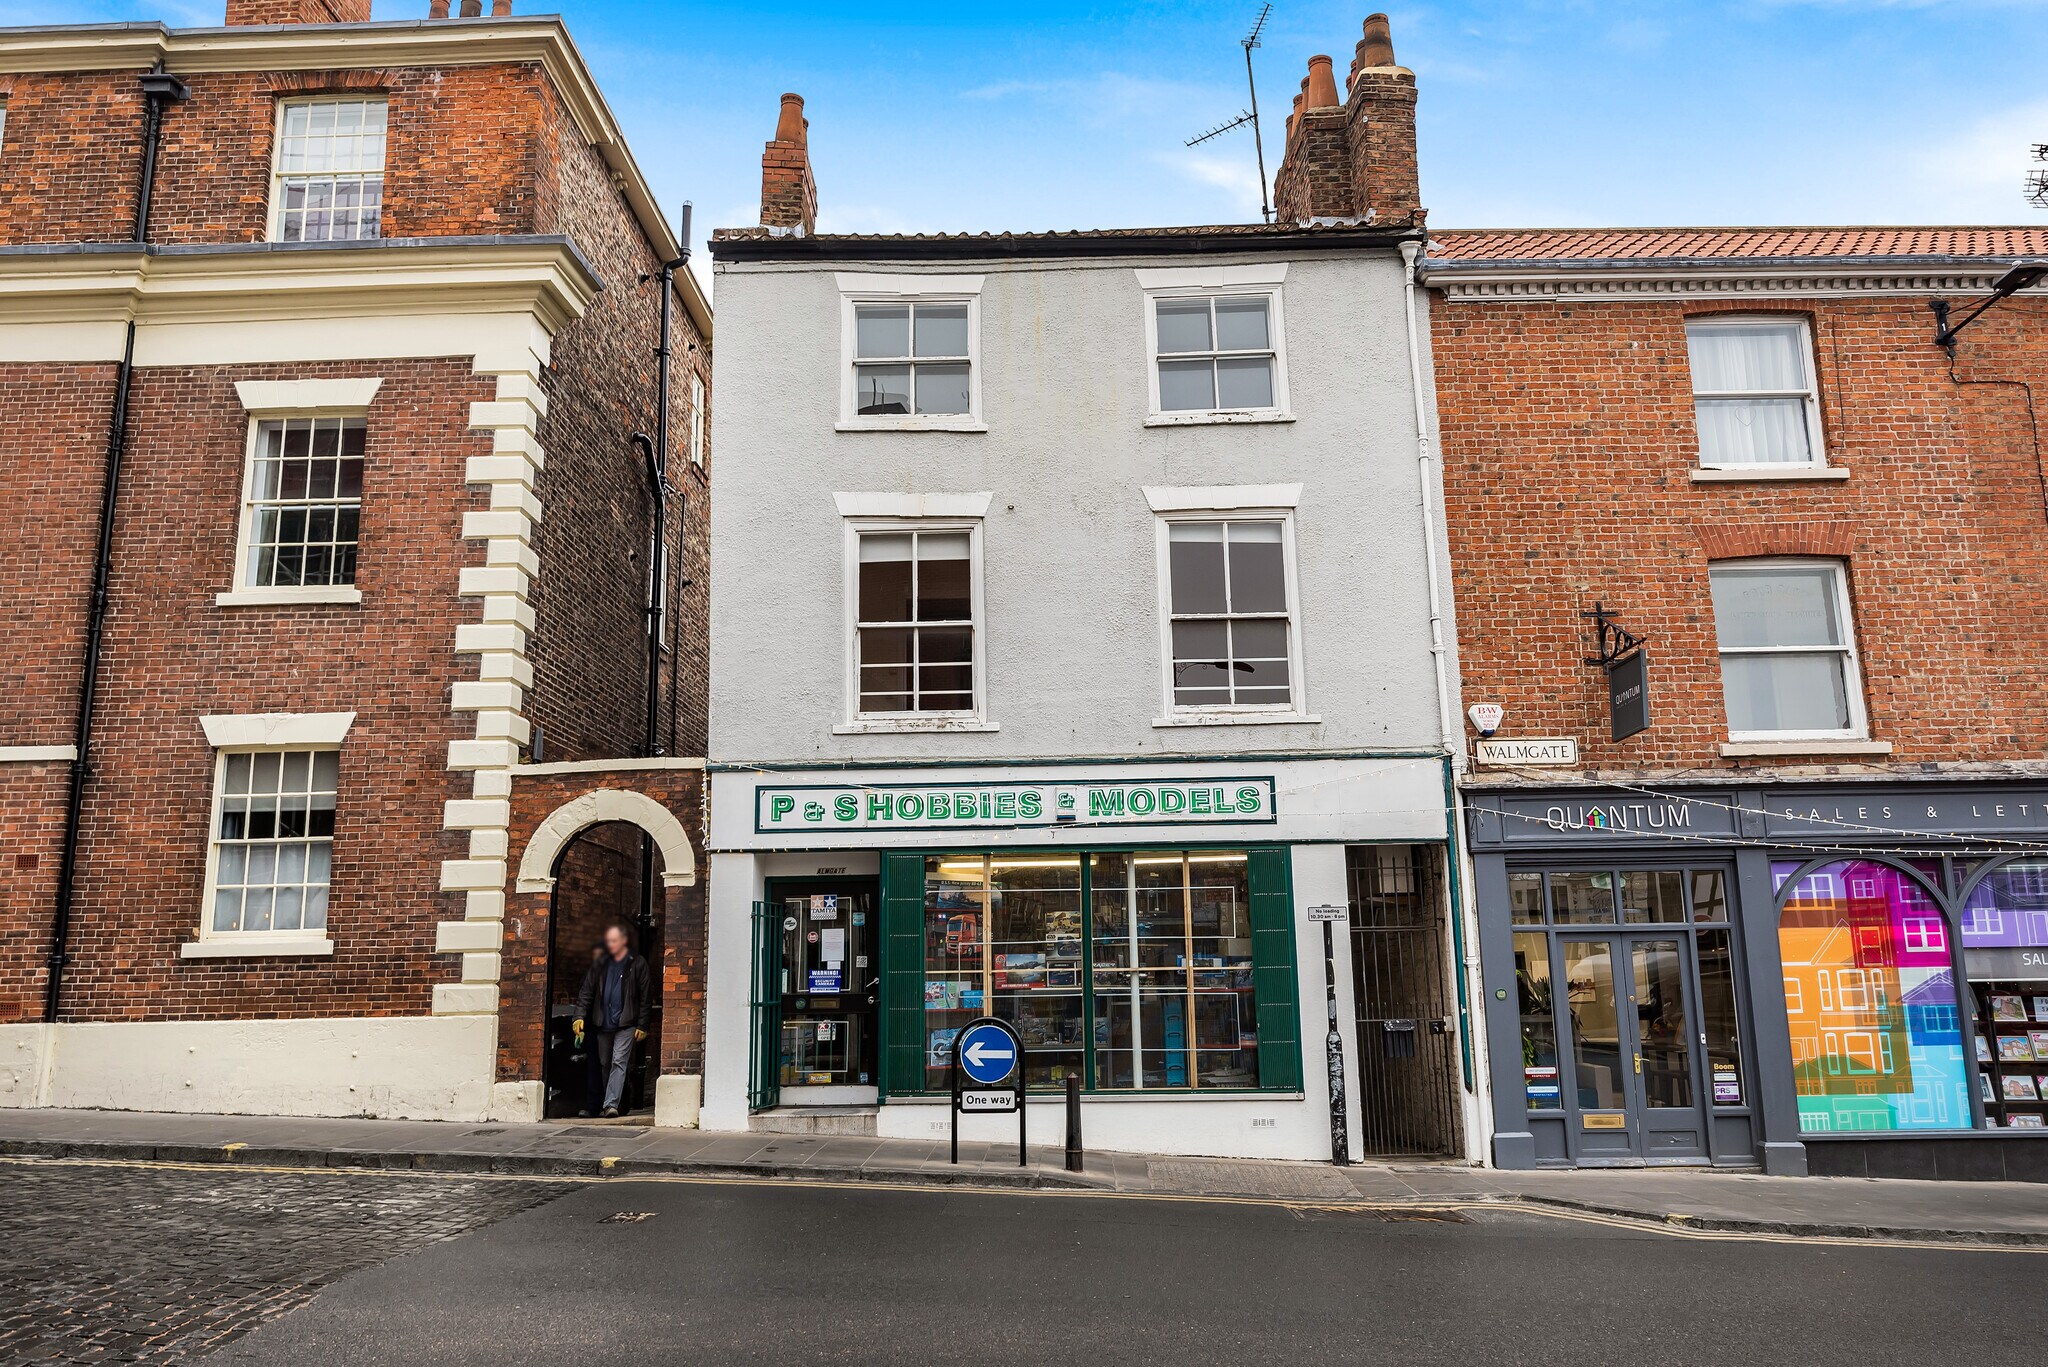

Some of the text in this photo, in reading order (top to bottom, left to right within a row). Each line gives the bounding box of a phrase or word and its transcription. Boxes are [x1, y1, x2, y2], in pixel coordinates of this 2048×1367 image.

[1482, 745, 1570, 759] WALMGATE
[770, 786, 1261, 822] P & S HOBBIES & MODELS
[1546, 804, 1691, 832] QUANTUM
[1785, 805, 1891, 821] SALES
[1926, 806, 1938, 818] &
[966, 1095, 1011, 1106] One way
